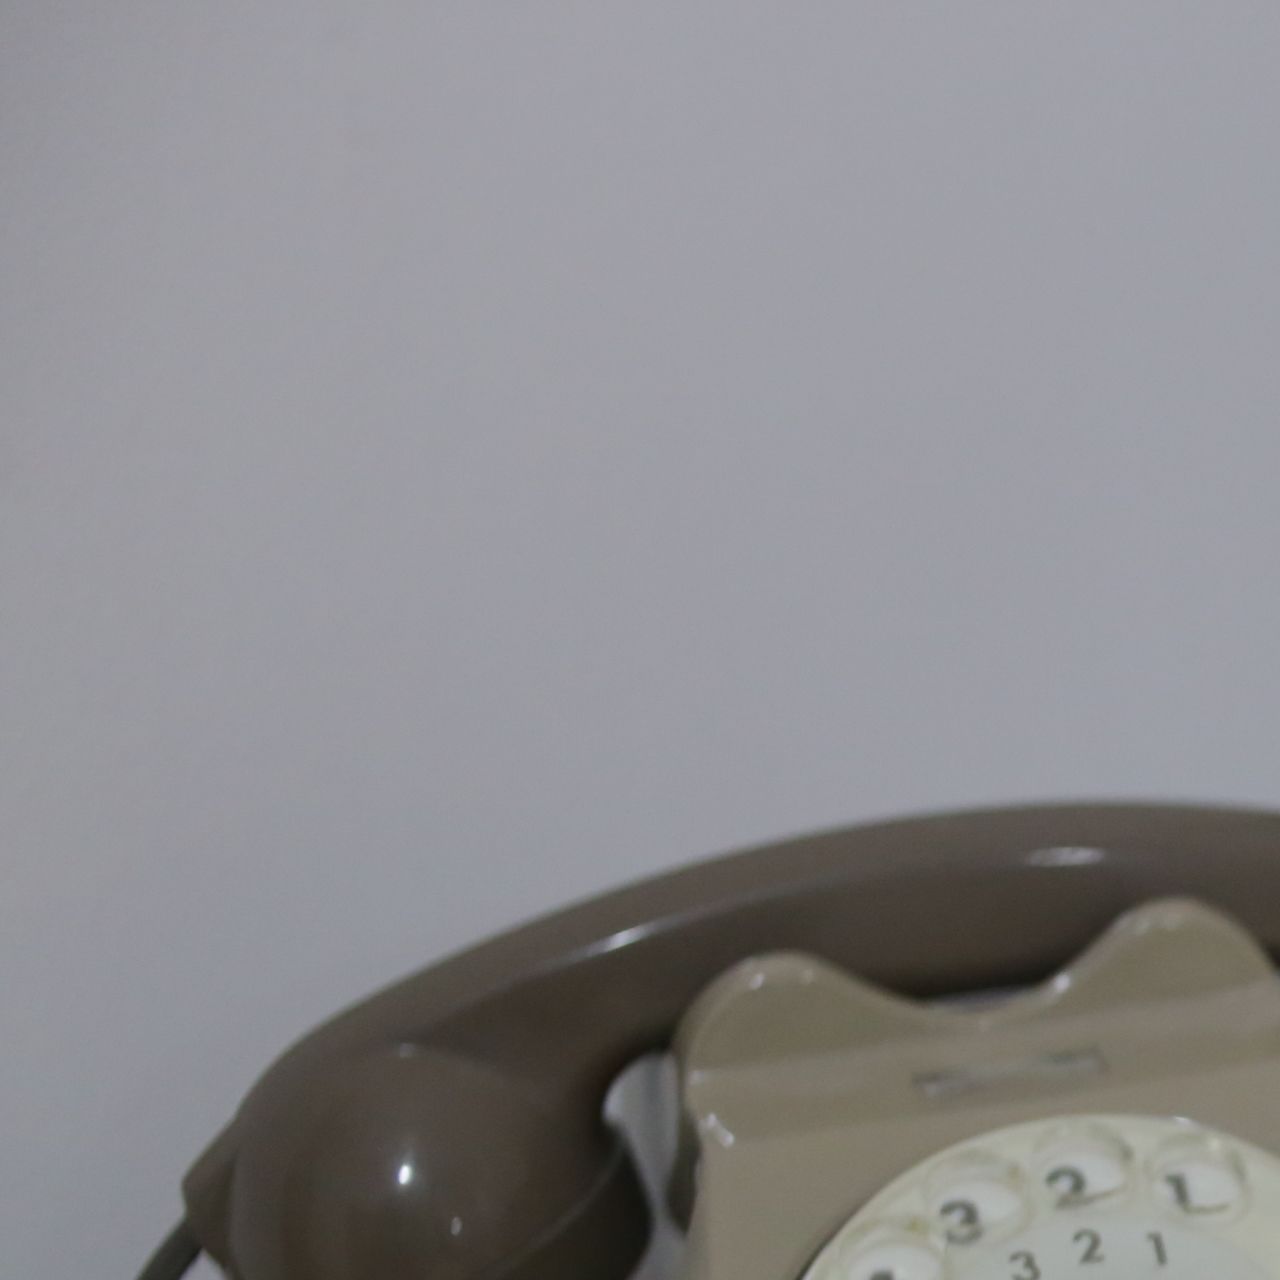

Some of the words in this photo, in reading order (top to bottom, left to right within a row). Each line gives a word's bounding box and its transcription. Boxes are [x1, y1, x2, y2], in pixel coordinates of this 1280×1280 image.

[1046, 1166, 1086, 1210] 2
[940, 1199, 984, 1246] 3
[1072, 1228, 1106, 1264] 2
[1147, 1231, 1168, 1267] 1
